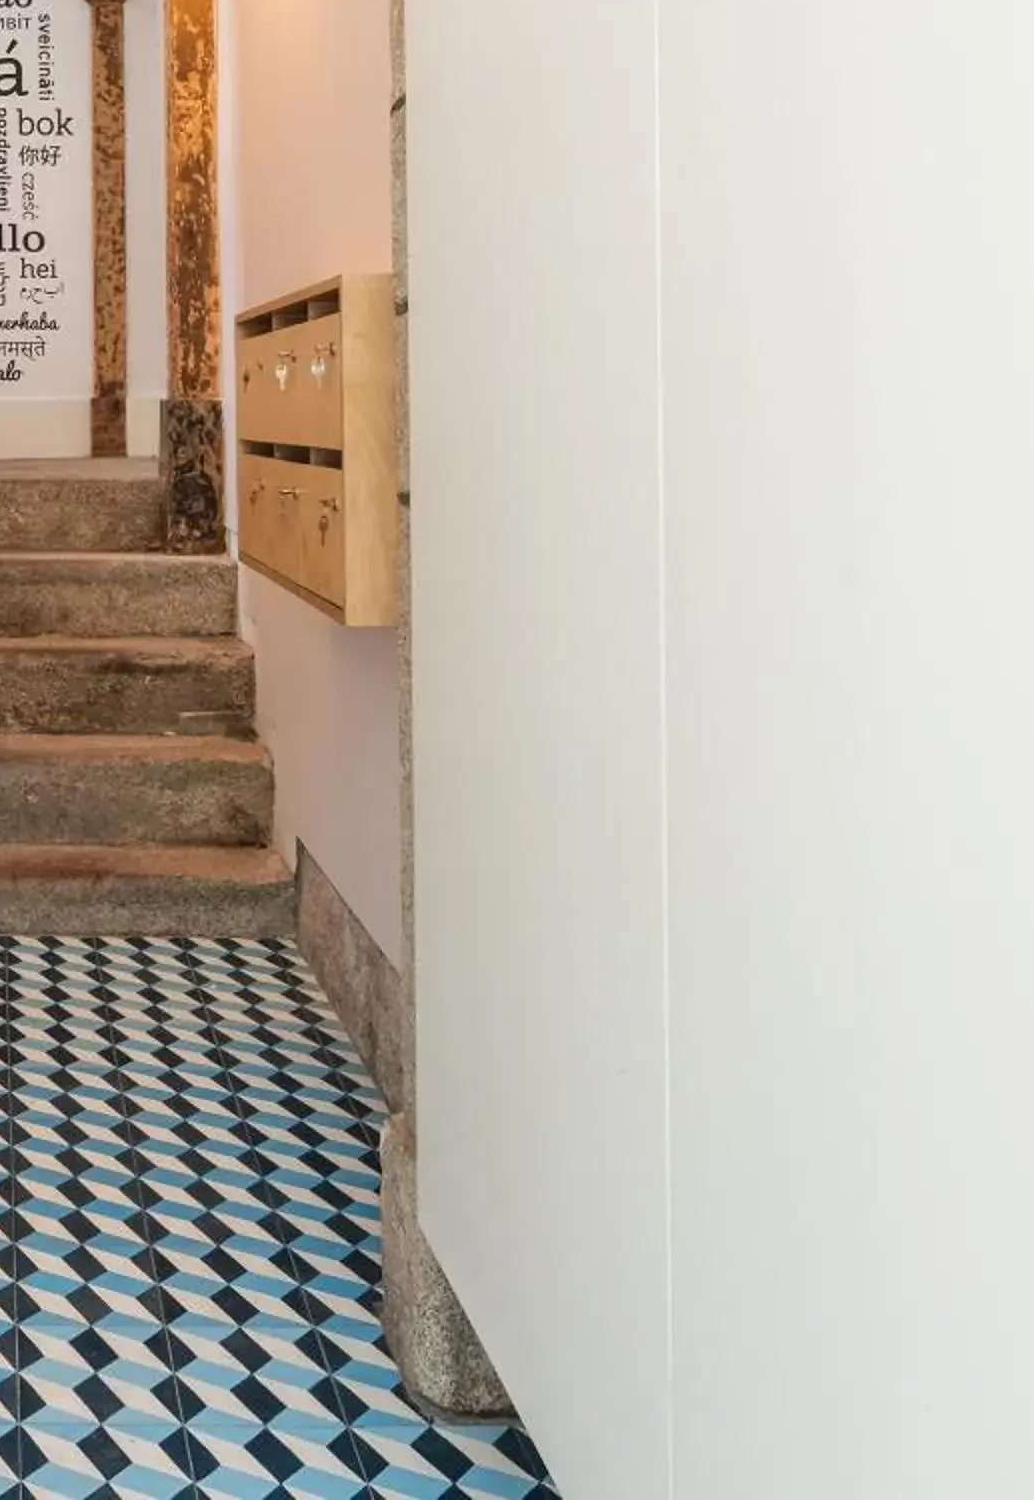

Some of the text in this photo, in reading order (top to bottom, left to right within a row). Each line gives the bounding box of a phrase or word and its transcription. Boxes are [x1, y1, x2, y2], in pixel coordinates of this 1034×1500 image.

[38, 13, 55, 100] sveicināti
[17, 107, 74, 137] bok
[18, 143, 62, 167] 你好
[19, 257, 58, 279] hei
